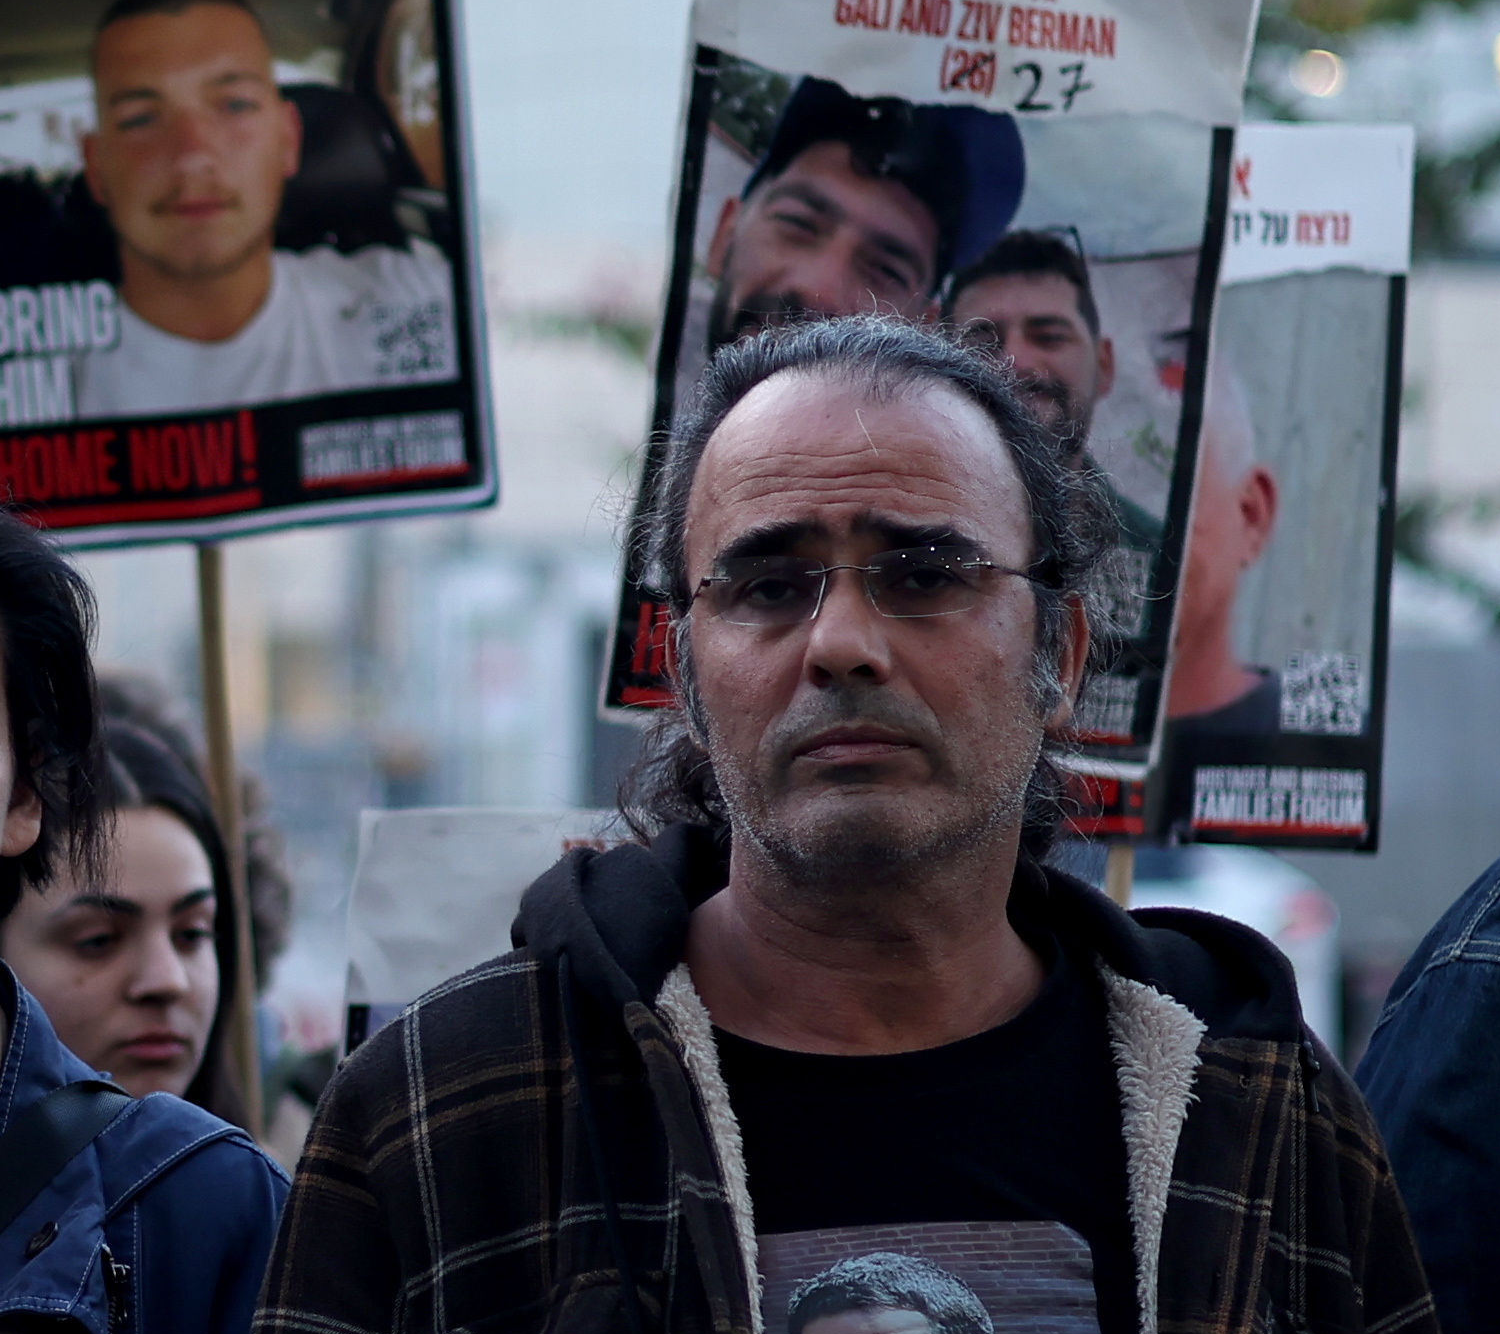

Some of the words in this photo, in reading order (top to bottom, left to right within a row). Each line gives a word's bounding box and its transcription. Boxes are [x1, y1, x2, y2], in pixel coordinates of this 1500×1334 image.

[1008, 5, 1117, 58] BERMAN
[1013, 61, 1094, 112] 27
[1259, 208, 1289, 245] על
[1296, 211, 1350, 245] נרצח
[129, 409, 258, 491] NOW!
[1195, 790, 1285, 823] FAMILIES
[1290, 791, 1364, 827] FORUM
